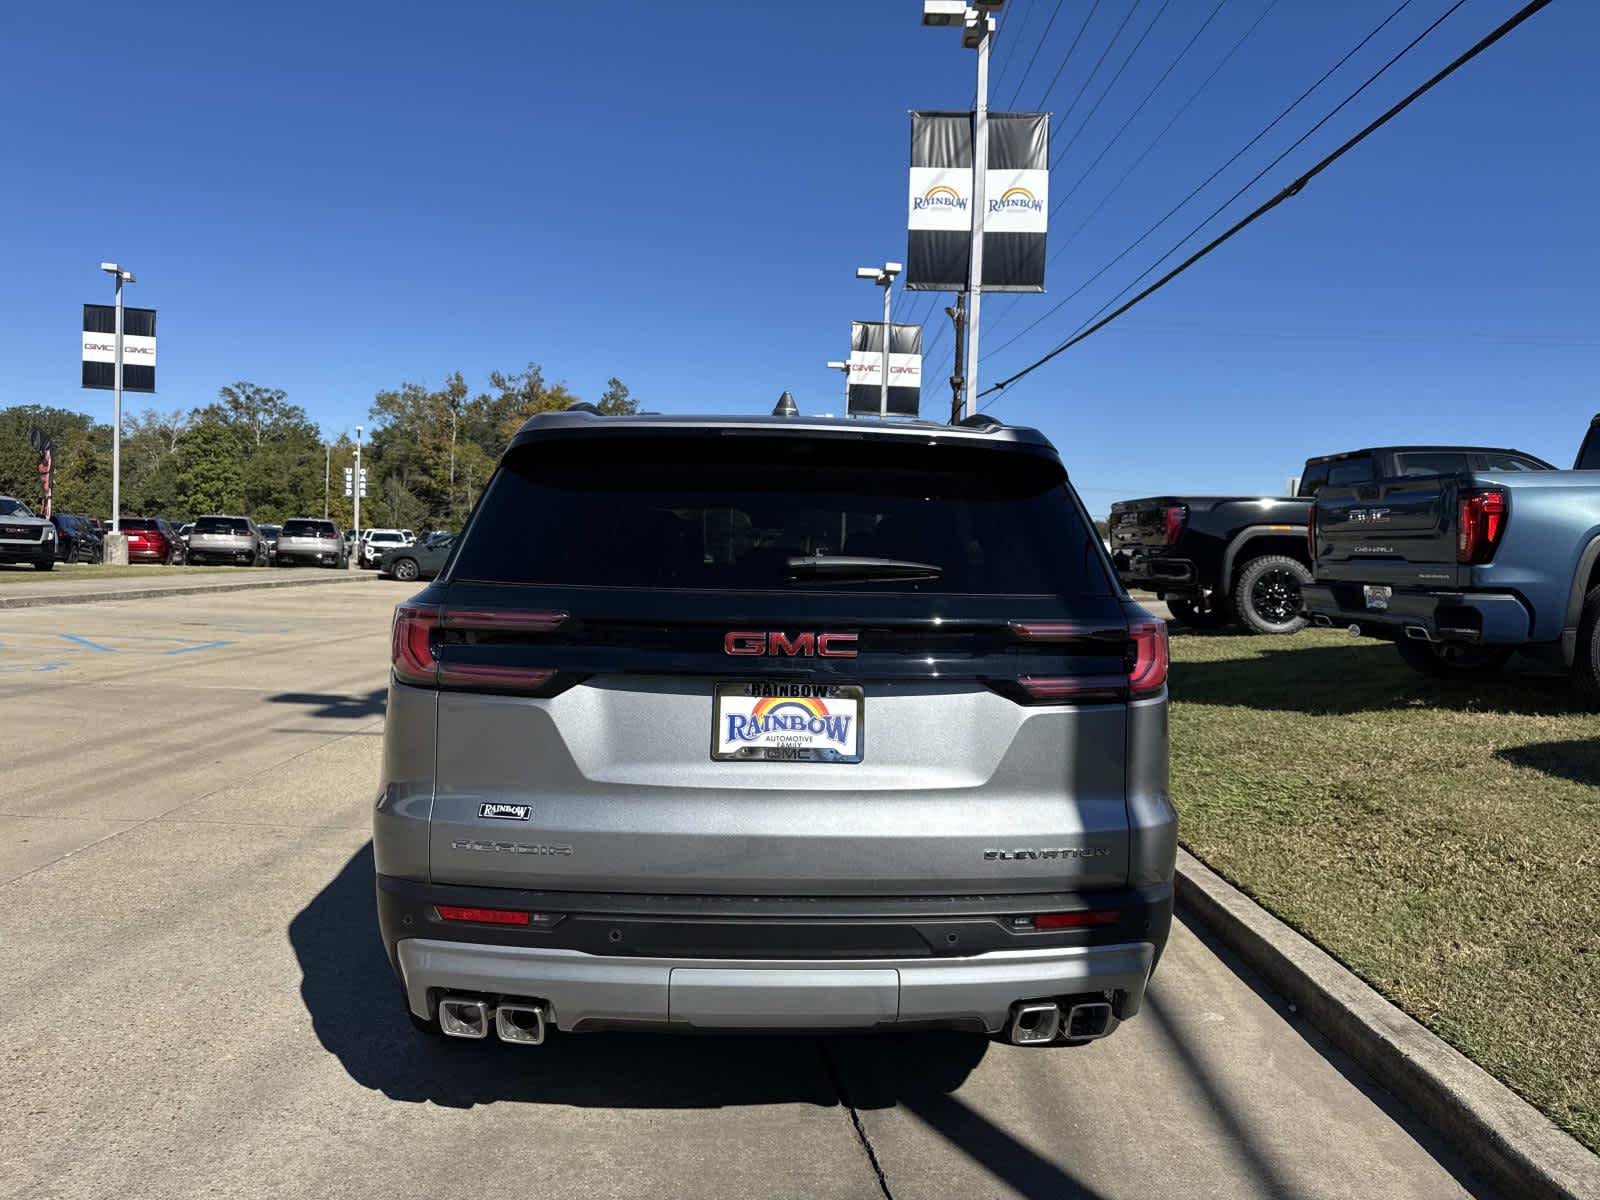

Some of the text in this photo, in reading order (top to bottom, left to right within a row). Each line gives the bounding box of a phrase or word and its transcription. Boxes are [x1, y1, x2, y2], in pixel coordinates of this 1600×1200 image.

[913, 197, 968, 210] RAINBOW
[989, 199, 1043, 212] RAINBOW
[84, 343, 114, 351] GMC
[124, 346, 154, 354] GMC
[852, 364, 881, 372] GMC
[890, 366, 920, 374] GMC
[724, 631, 859, 657] GMC
[750, 682, 828, 697] RAINBOW
[726, 714, 852, 744] RAINBOW
[765, 735, 813, 743] AUTOMOTIVE
[484, 804, 528, 818] RAINBOW
[983, 848, 1110, 861] ELEVATION
